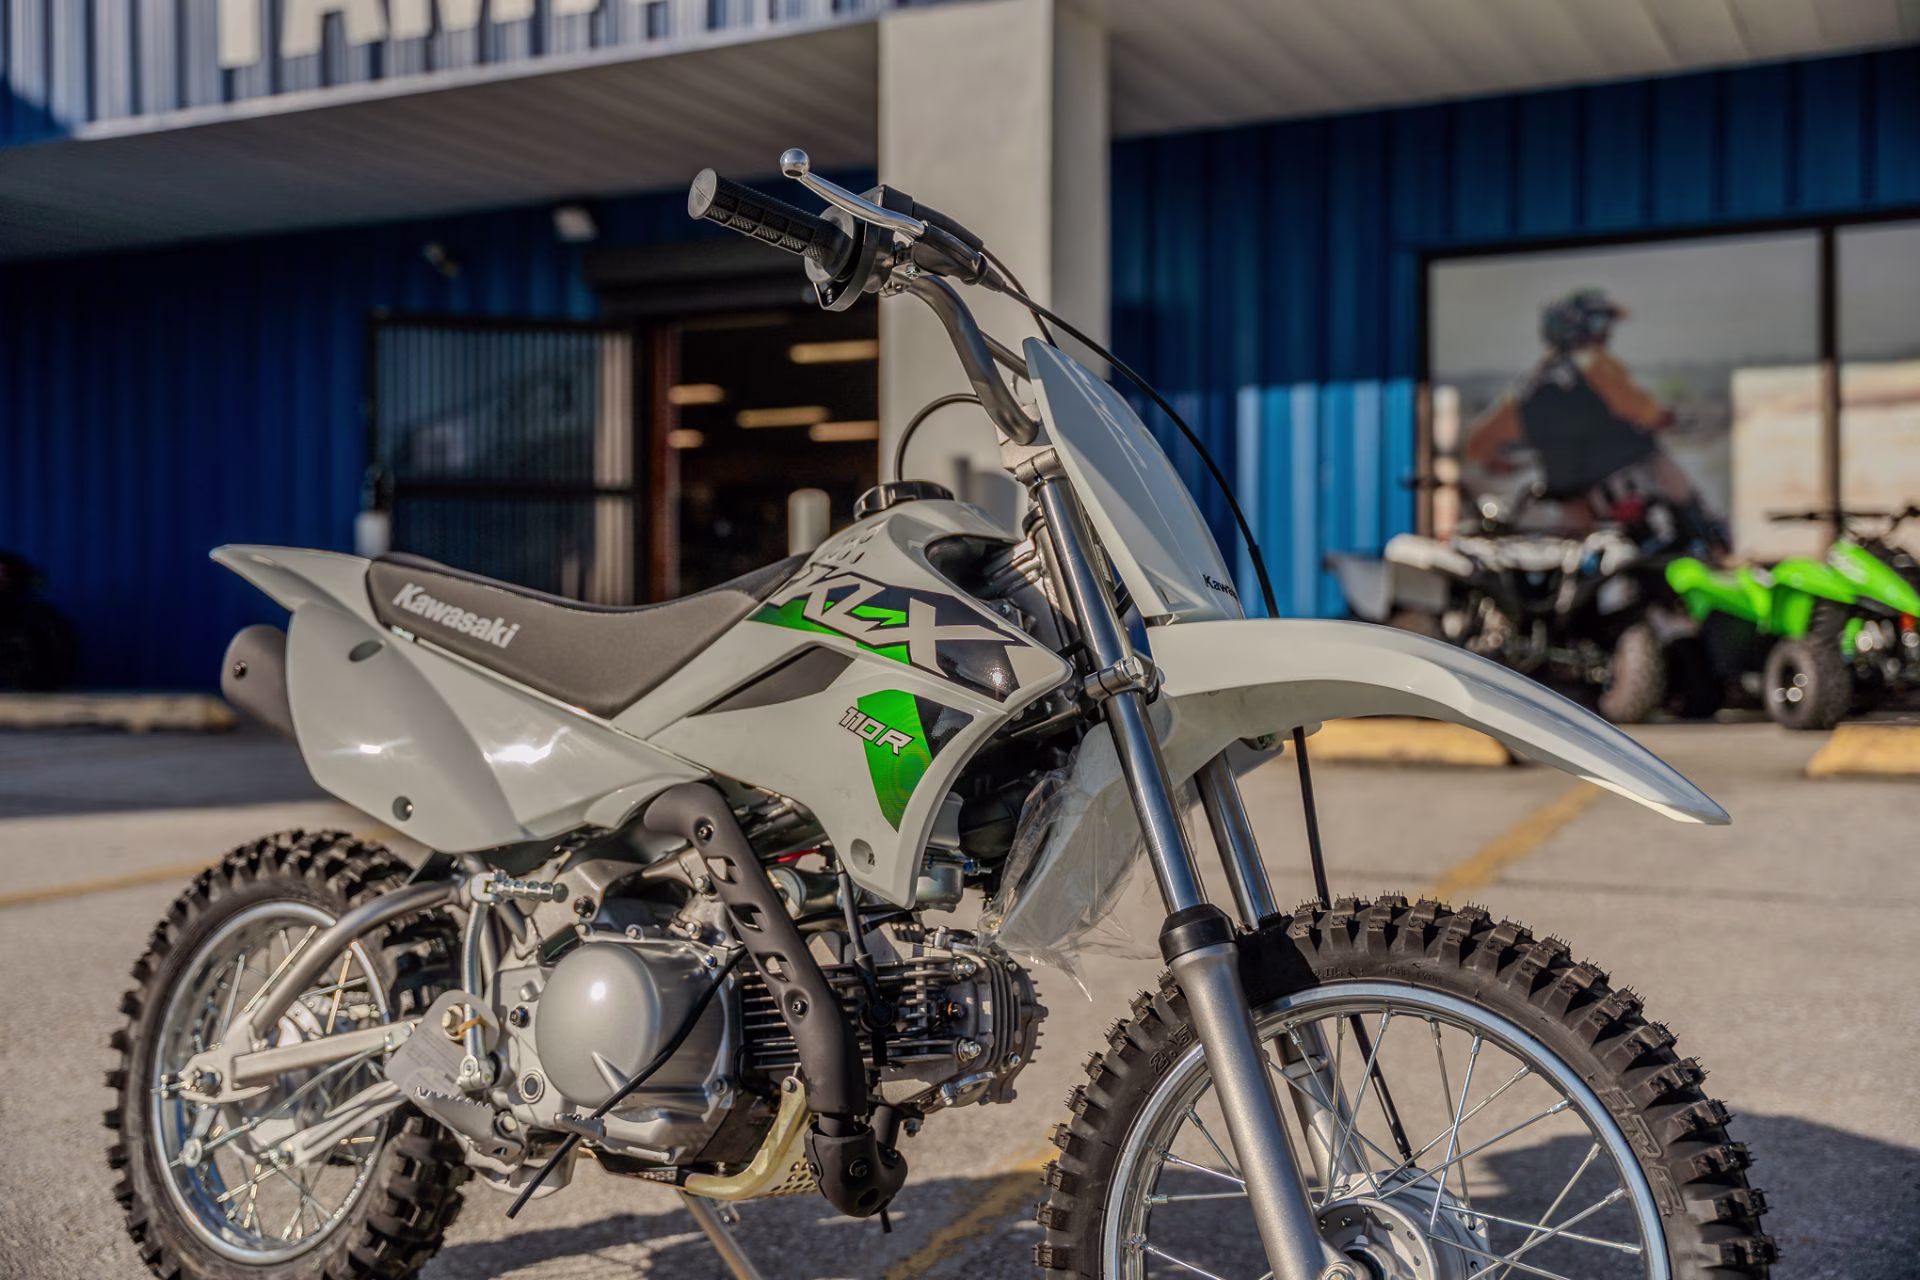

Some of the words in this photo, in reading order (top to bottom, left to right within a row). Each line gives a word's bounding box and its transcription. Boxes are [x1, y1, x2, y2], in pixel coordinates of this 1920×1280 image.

[392, 582, 521, 649] Kawasaki
[767, 562, 1016, 678] KLX
[839, 705, 915, 757] 110R
